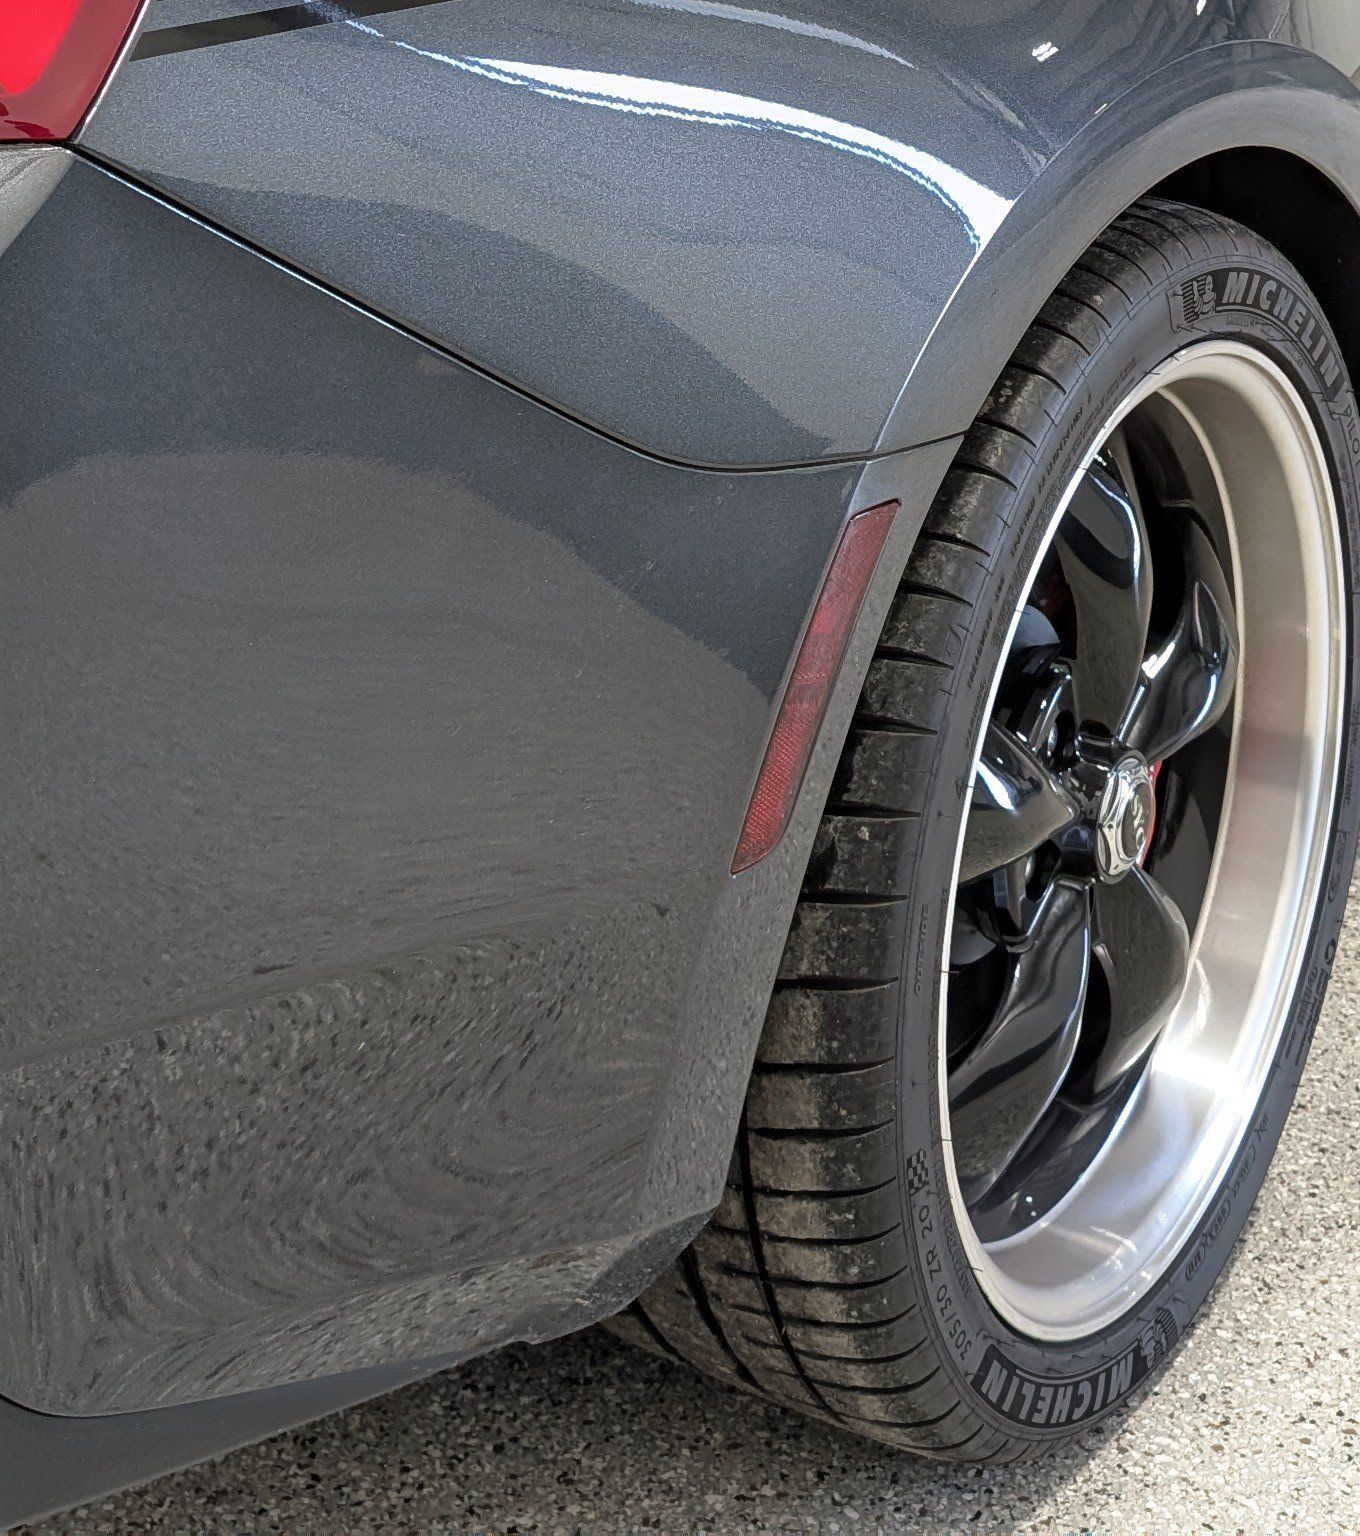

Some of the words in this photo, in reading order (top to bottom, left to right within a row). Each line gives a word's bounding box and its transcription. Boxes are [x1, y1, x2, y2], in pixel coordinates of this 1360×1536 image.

[1221, 271, 1341, 388] MICHELIN
[918, 1204, 934, 1240] 20
[926, 1244, 942, 1282] ZR
[936, 1284, 973, 1362] 305/30
[981, 1352, 1134, 1424] MICHELIN
